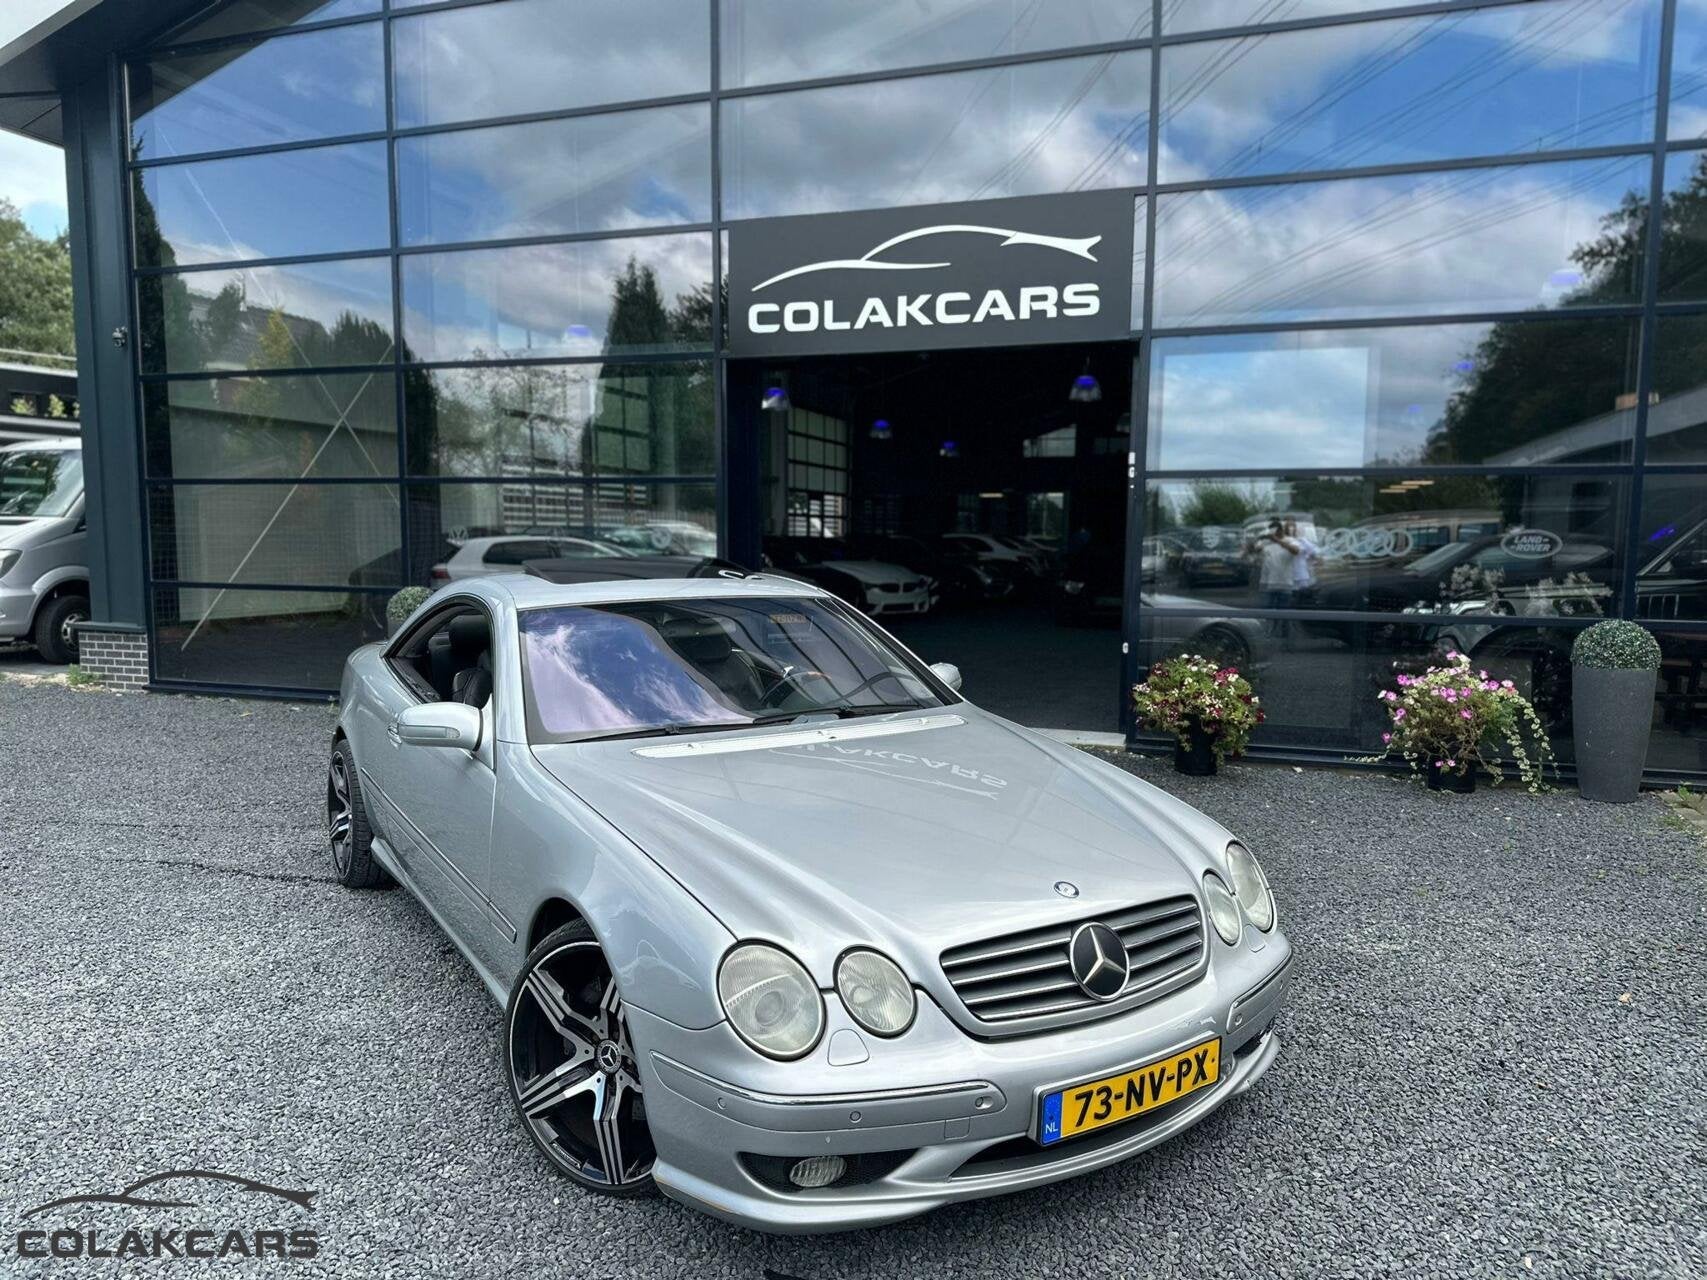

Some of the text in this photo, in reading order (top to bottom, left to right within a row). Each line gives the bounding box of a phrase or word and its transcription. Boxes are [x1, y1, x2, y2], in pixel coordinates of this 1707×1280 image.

[748, 283, 1100, 333] COLAKCARS
[1075, 1048, 1209, 1128] 73-NV-PX
[1045, 1122, 1059, 1133] NL
